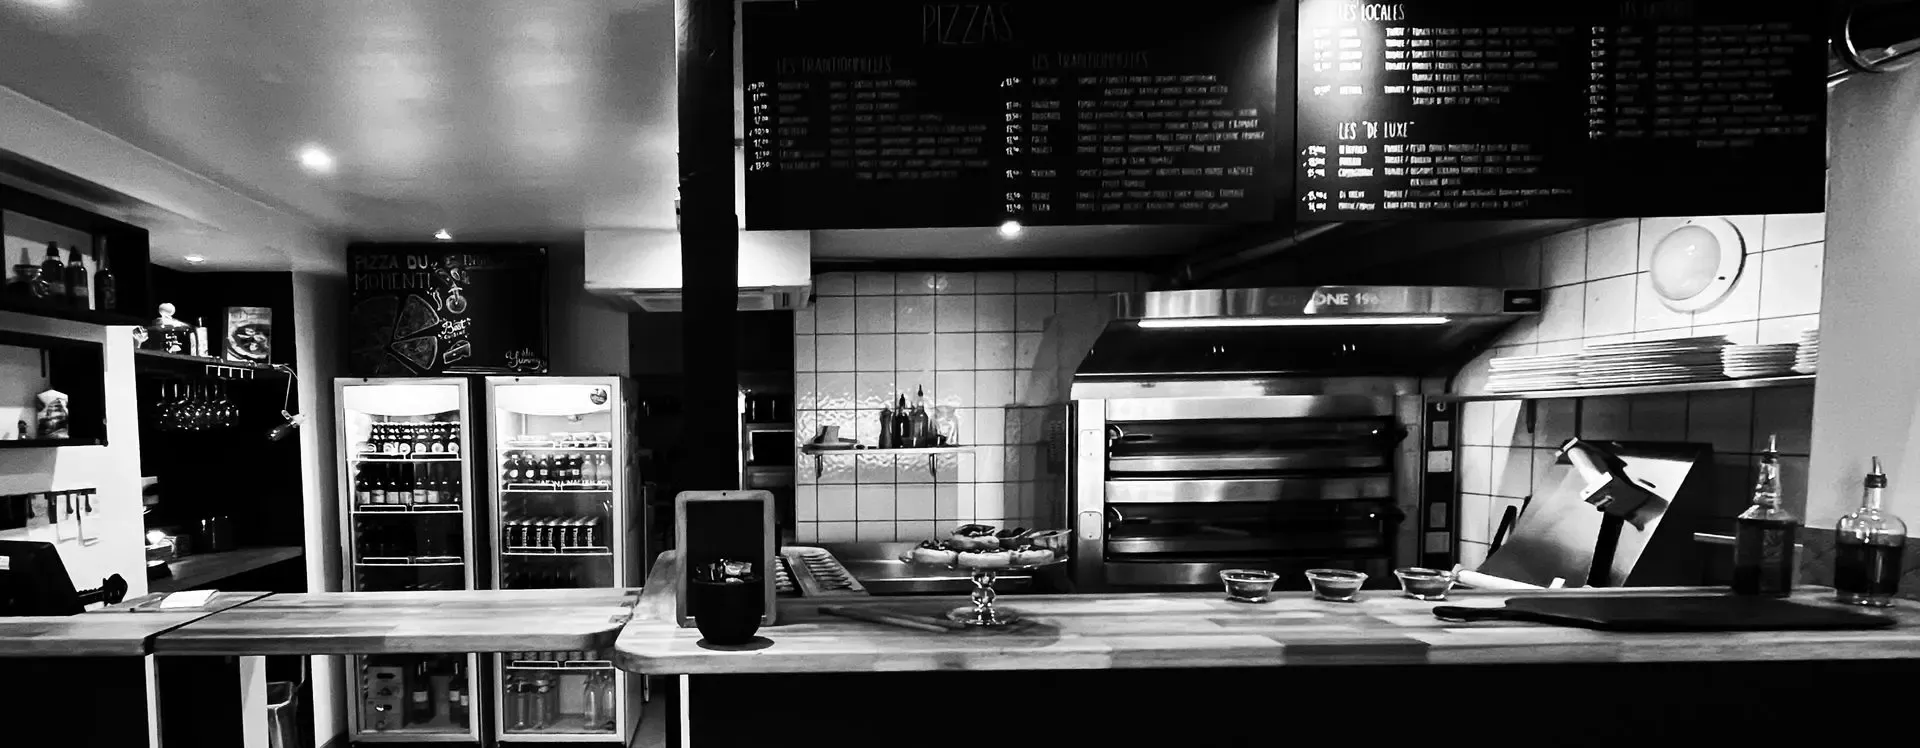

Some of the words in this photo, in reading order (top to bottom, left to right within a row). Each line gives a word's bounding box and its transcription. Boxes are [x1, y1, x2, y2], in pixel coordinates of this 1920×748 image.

[1338, 4, 1357, 21] LES
[1361, 3, 1405, 21] LOCALES
[922, 3, 1013, 44] PIZZAS
[1338, 121, 1357, 140] LES
[355, 254, 399, 271] PIZZA
[406, 253, 428, 270] DU
